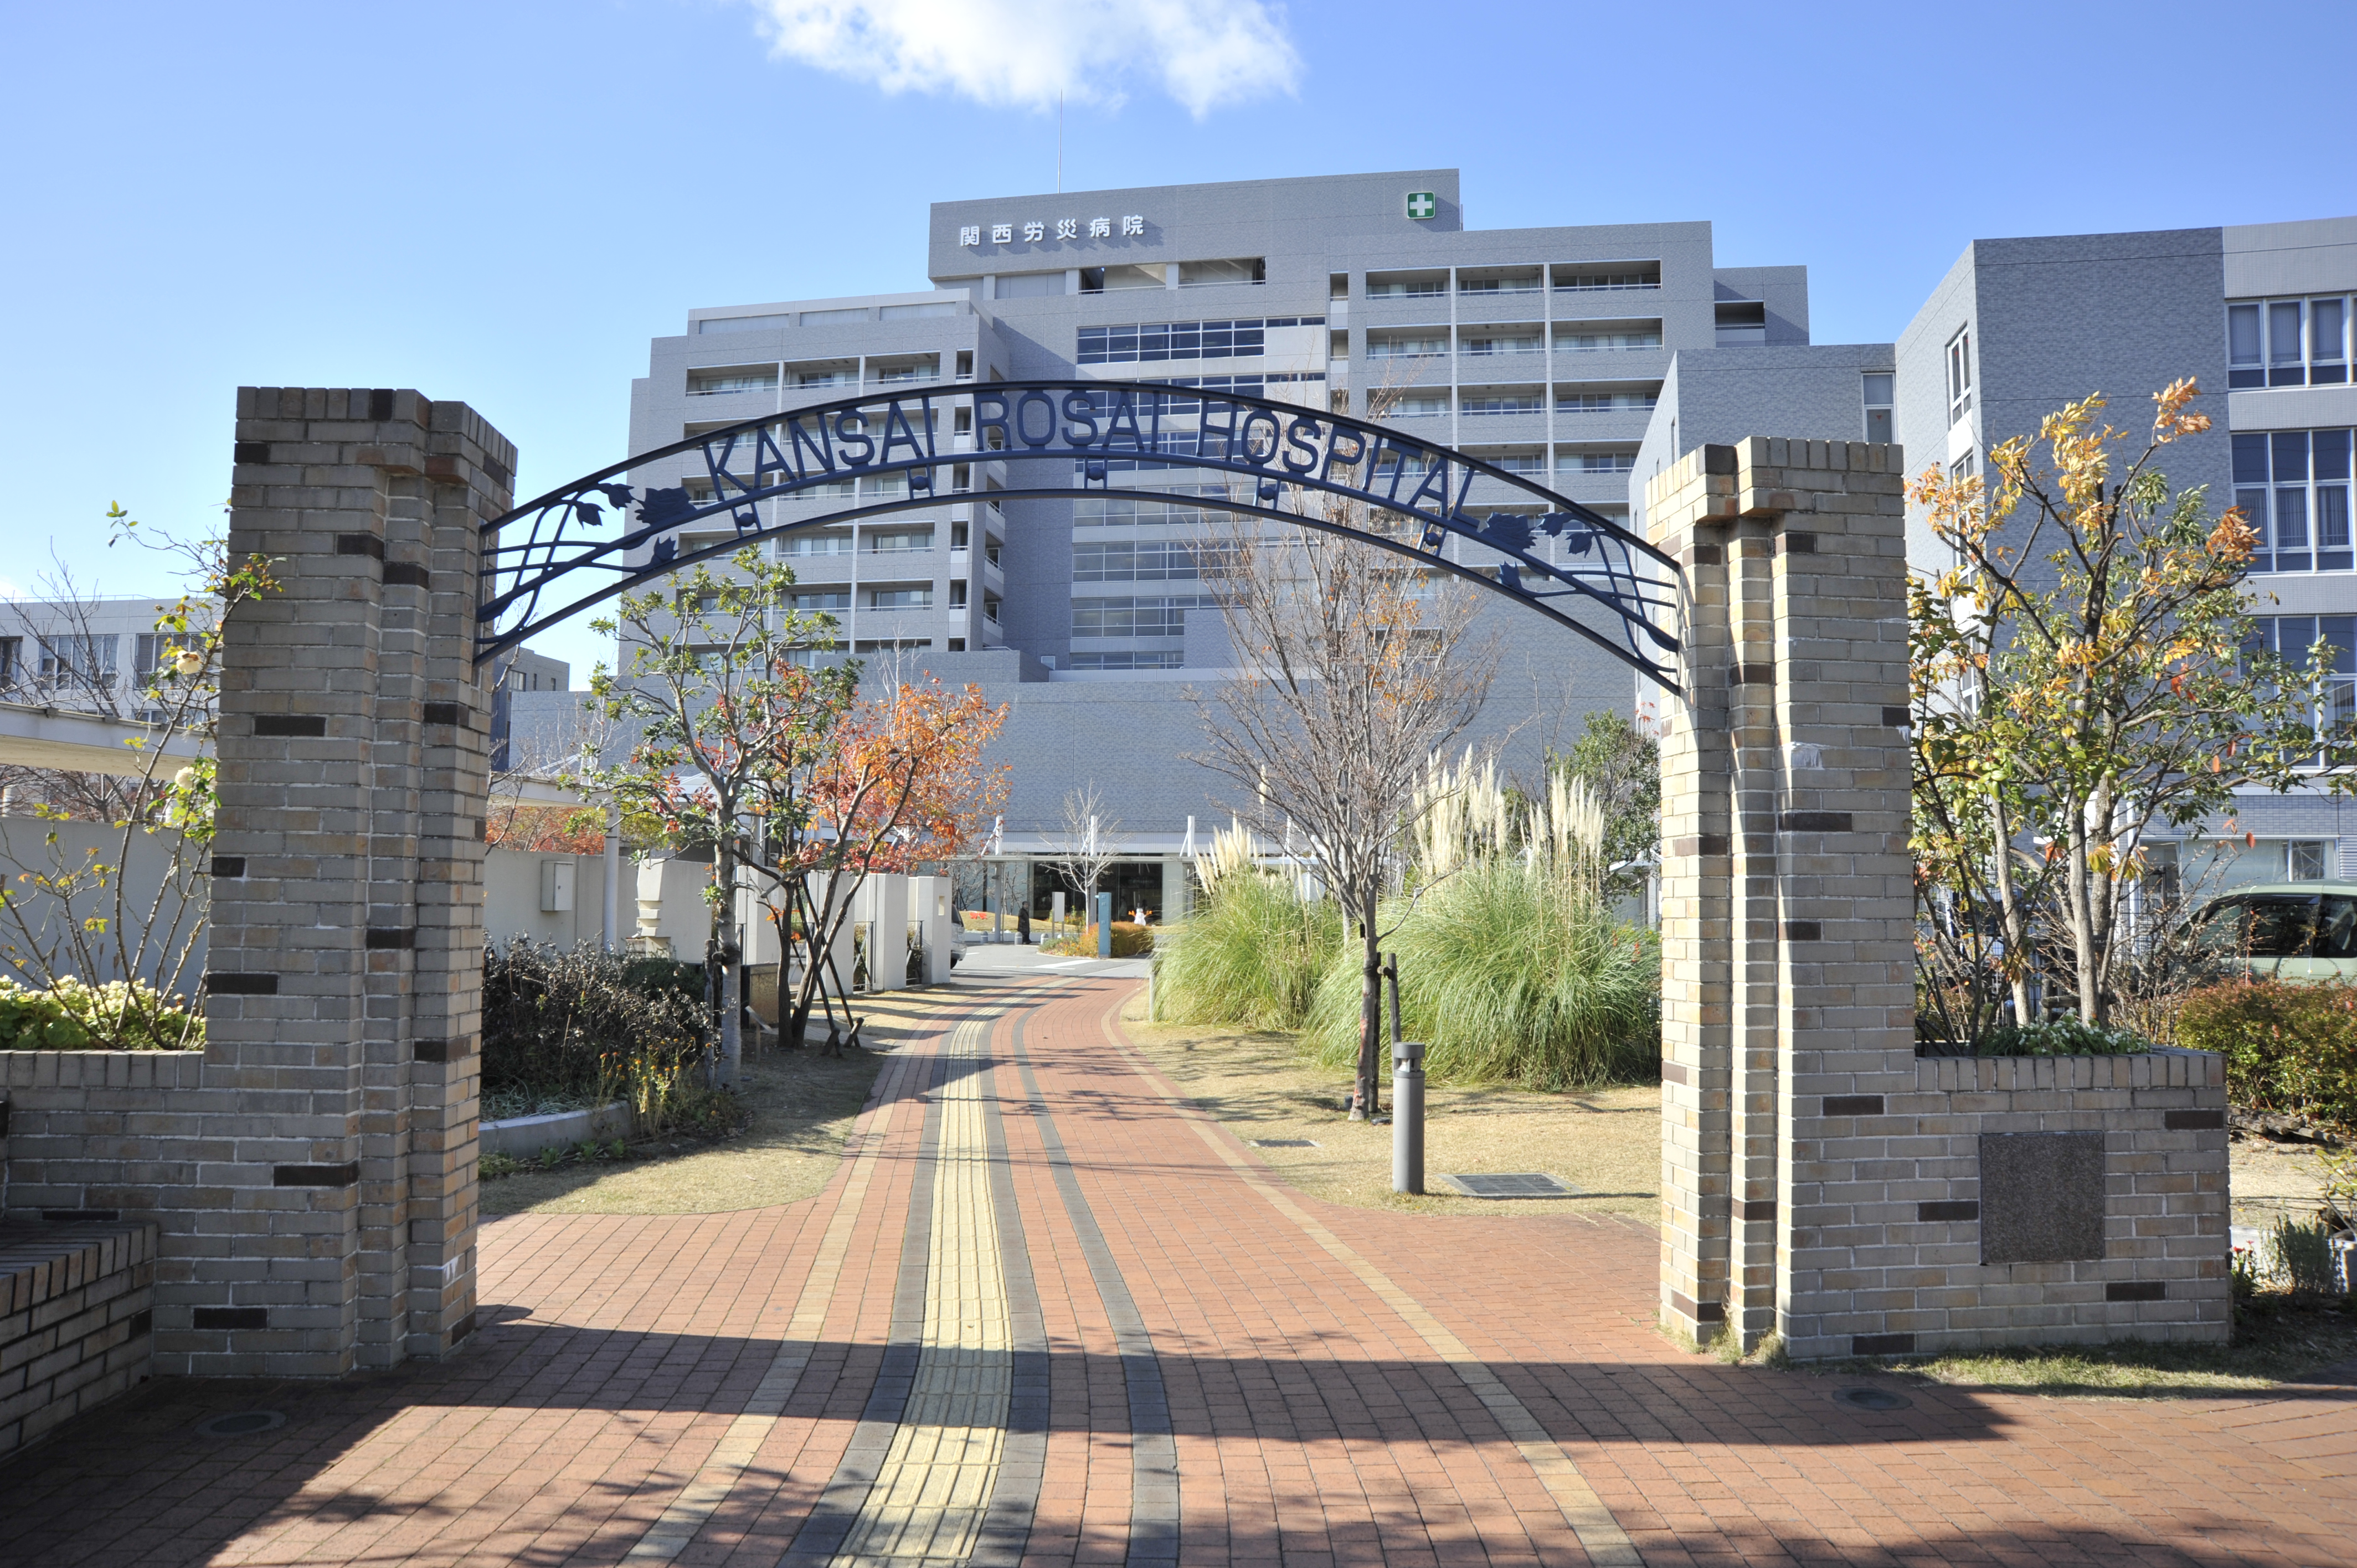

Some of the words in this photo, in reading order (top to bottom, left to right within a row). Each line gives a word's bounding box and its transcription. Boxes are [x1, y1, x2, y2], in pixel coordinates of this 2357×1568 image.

[960, 215, 1144, 246] 関西労災病院
[702, 395, 936, 501] KANSAI
[972, 390, 1160, 452] ROSAI
[1195, 395, 1480, 529] HOSPITAL
